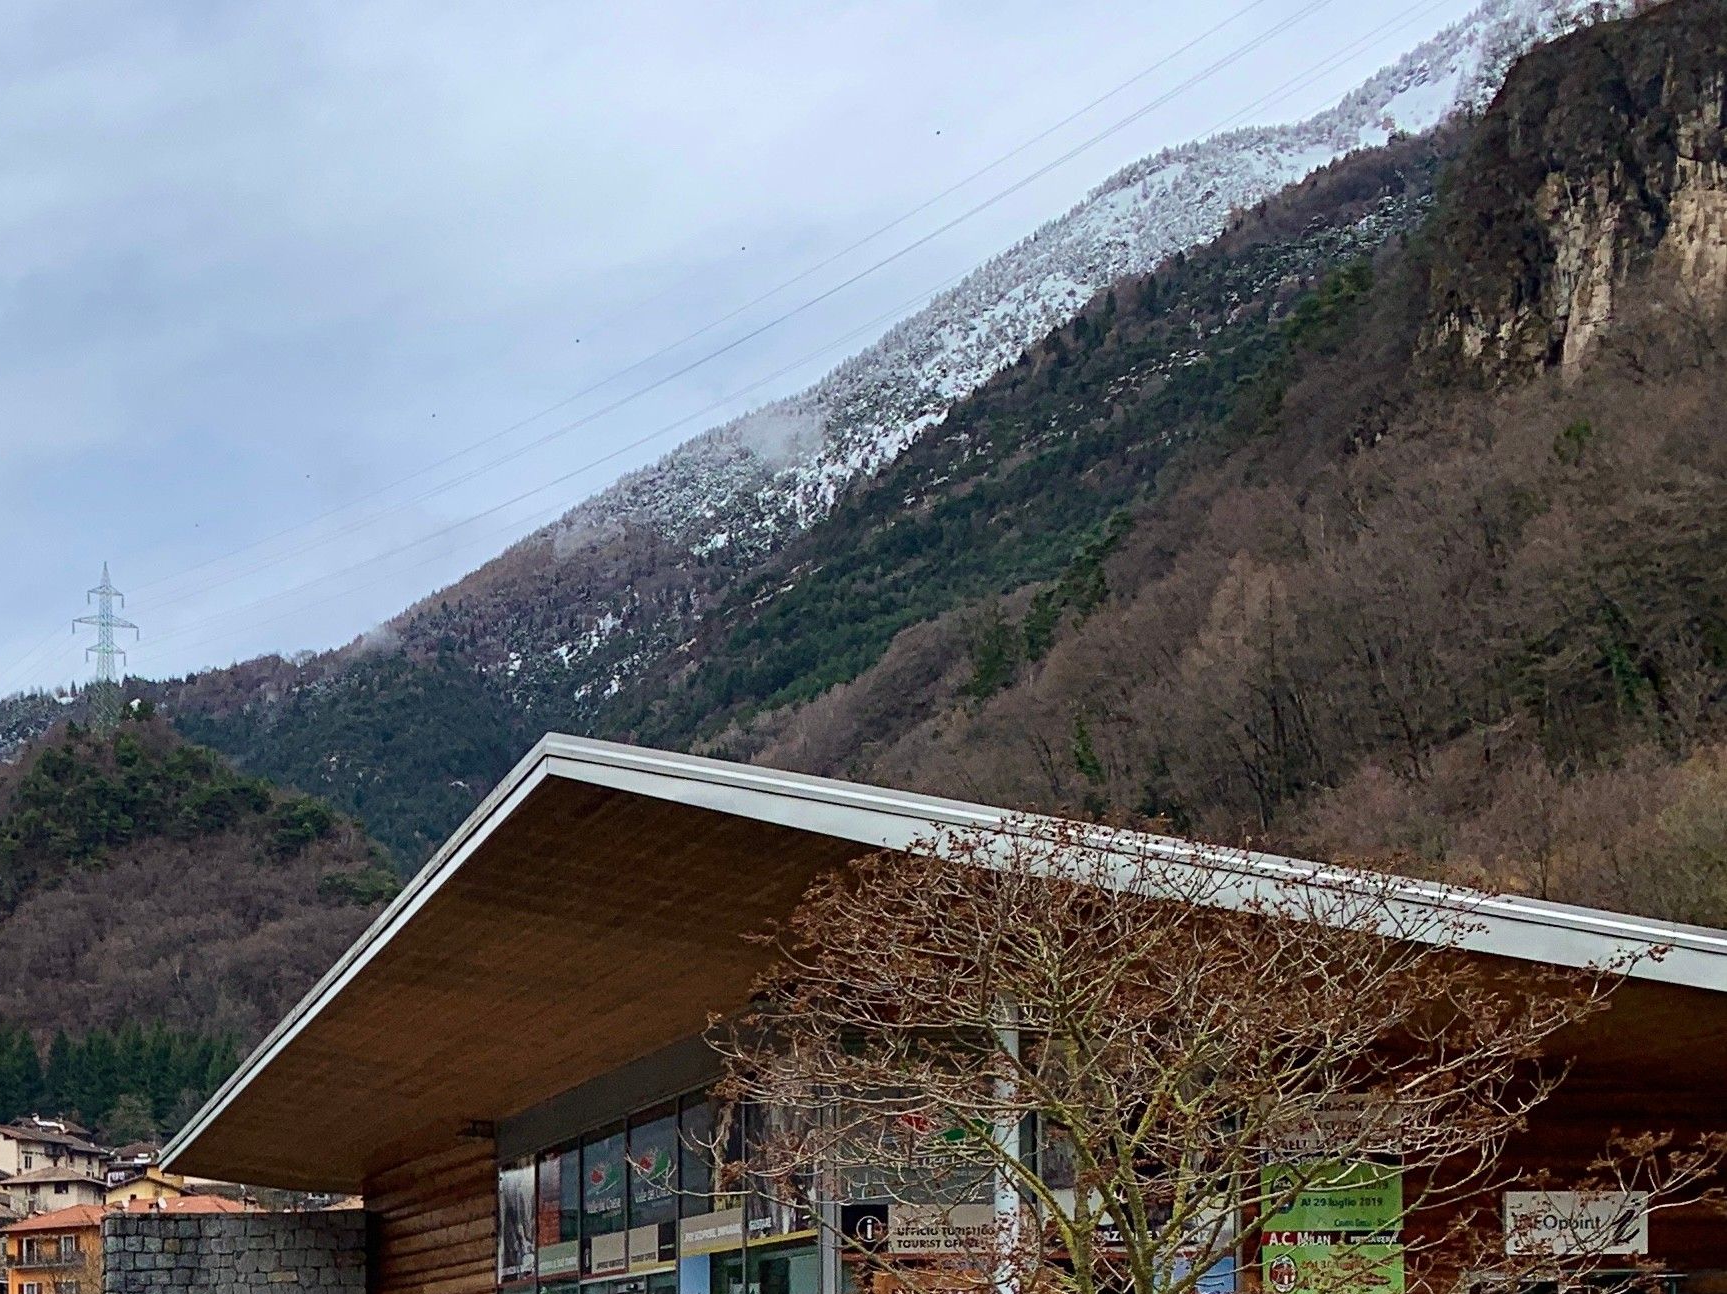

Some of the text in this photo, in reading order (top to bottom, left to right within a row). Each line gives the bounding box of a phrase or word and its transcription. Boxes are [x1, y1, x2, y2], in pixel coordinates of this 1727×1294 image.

[1358, 1196, 1383, 1208] 2019
[896, 1226, 939, 1236] UFFICIO
[896, 1238, 941, 1249] TOURIST
